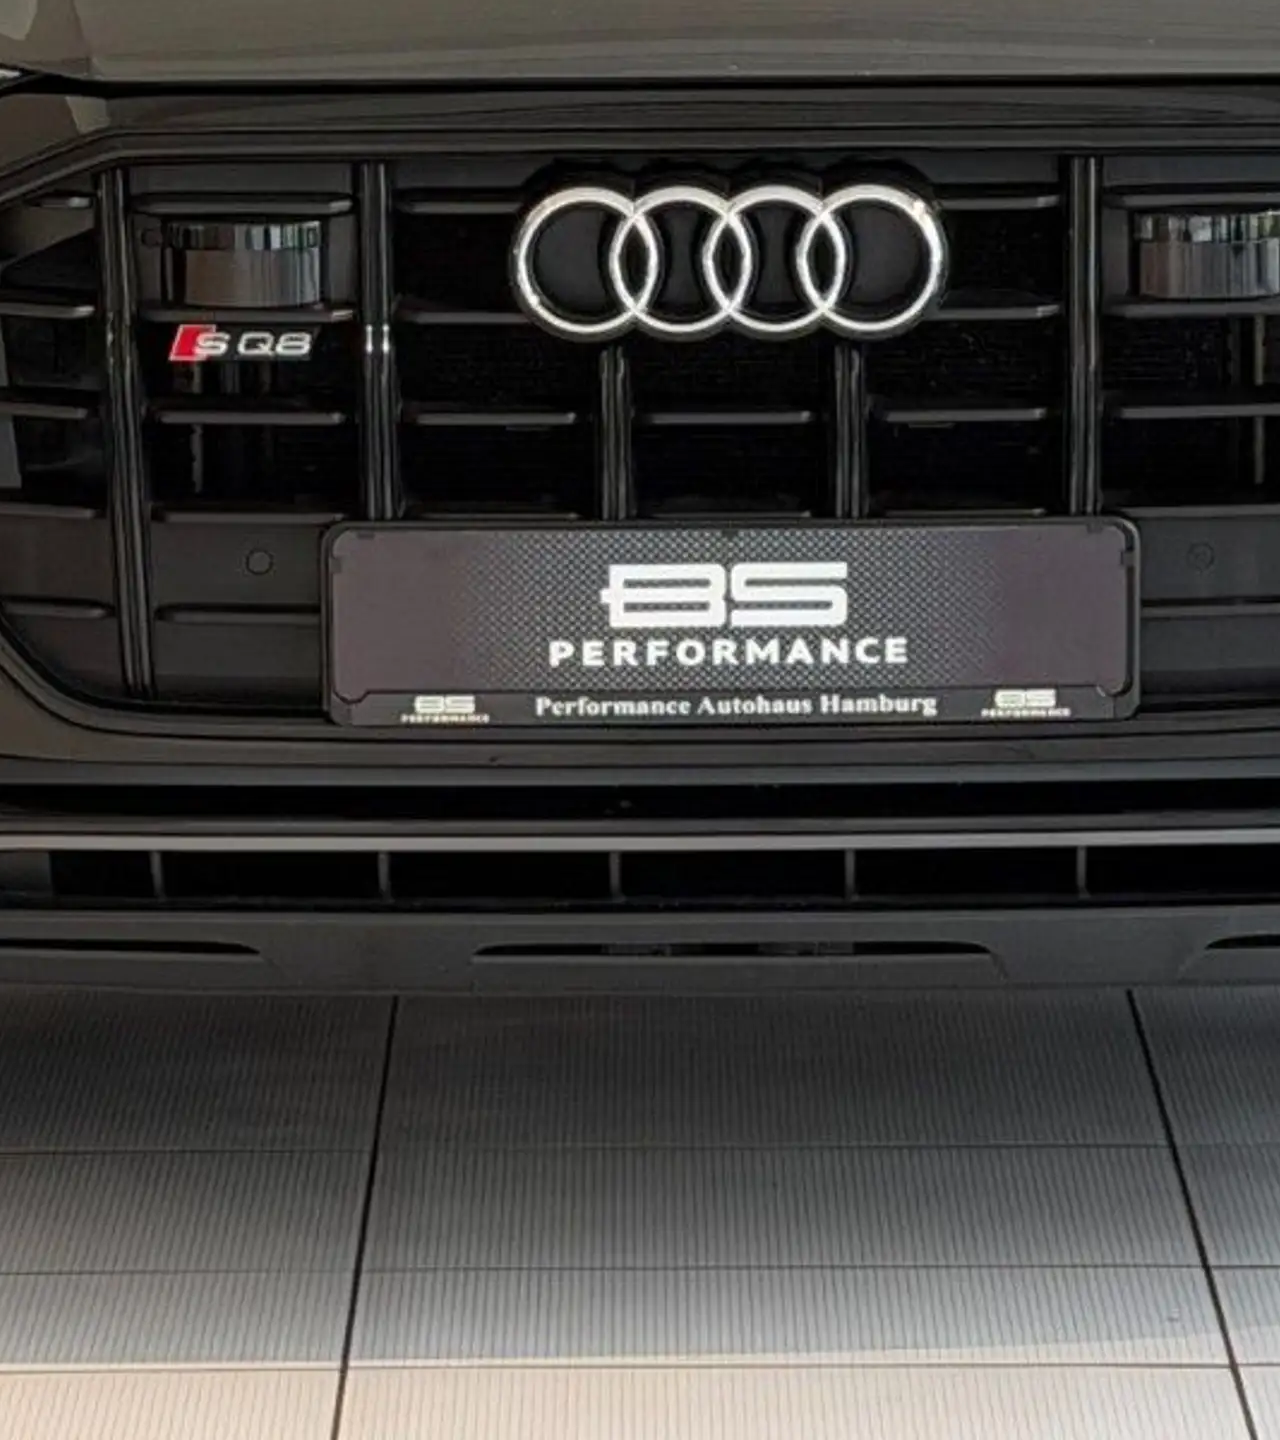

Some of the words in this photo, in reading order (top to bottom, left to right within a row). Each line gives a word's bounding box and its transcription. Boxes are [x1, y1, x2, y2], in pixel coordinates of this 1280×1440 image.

[600, 561, 848, 629] BS
[548, 637, 910, 667] PERFORMANCE
[535, 696, 691, 717] Performance
[697, 695, 813, 716] Autohaus
[820, 693, 938, 717] Hamburg
